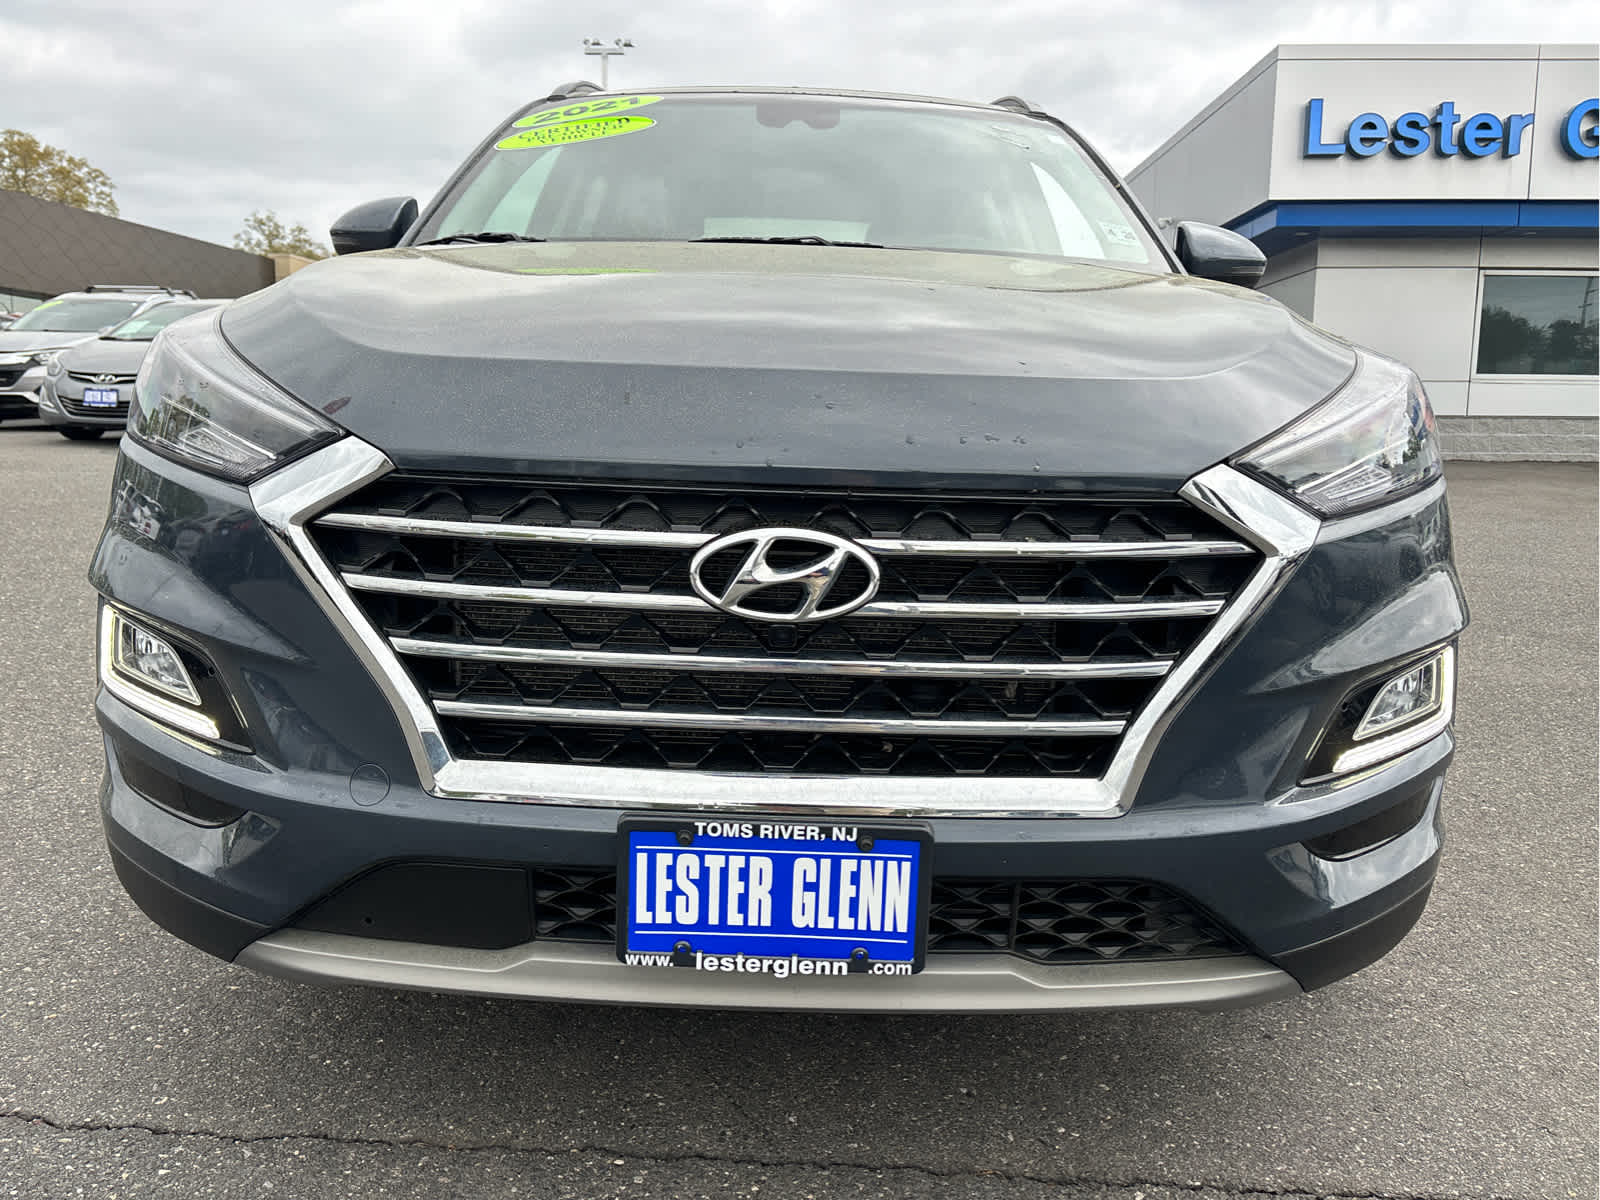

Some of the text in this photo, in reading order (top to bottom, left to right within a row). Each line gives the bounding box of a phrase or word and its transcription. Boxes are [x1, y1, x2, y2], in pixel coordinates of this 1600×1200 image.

[533, 97, 641, 125] 2021
[1304, 98, 1535, 158] Lester
[694, 822, 858, 842] TOMS RIVER, NJ
[635, 852, 912, 933] LESTER GLENN
[695, 952, 848, 978] lesterglenn
